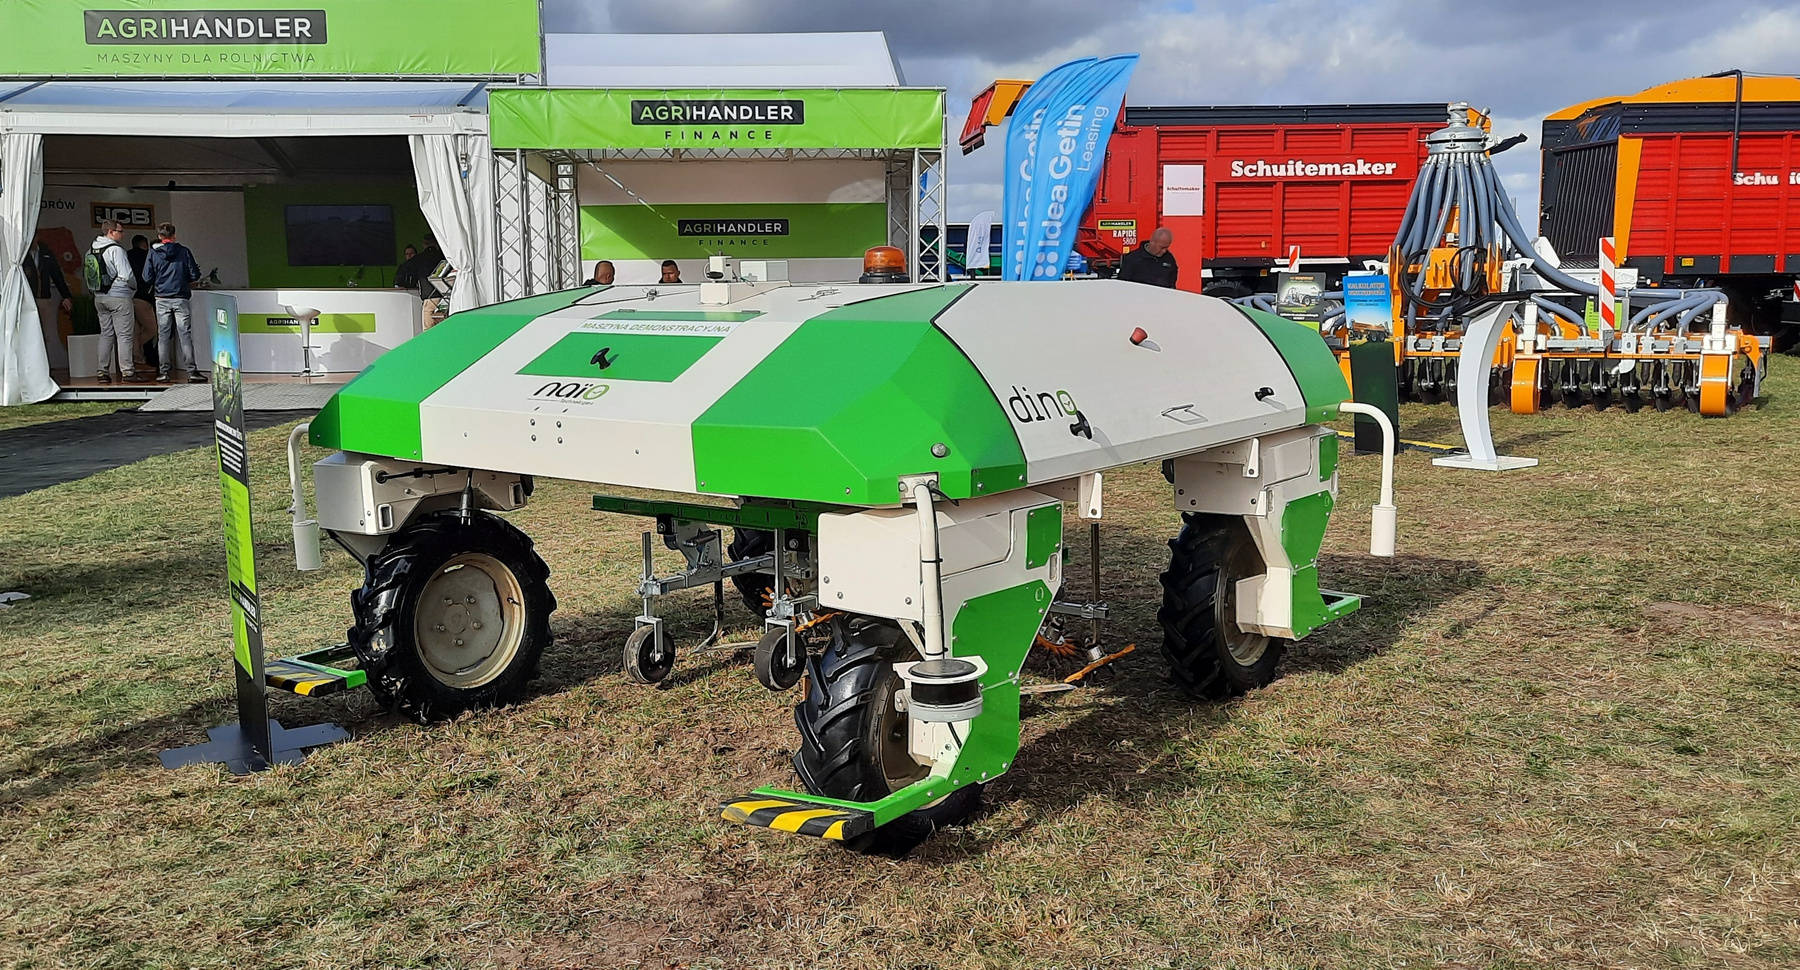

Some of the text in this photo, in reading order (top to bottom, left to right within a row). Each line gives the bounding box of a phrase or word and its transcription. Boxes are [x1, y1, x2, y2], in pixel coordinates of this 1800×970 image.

[97, 18, 312, 39] AGRIHANDLER
[97, 52, 316, 63] MASZYNY DLA ROLNICTWA
[640, 105, 794, 120] AGRIHANDLER
[665, 130, 772, 140] FINANCE
[1076, 106, 1110, 172] Leasing
[1038, 104, 1086, 247] Idea Getin
[1231, 159, 1397, 178] Schuitemaker
[95, 208, 151, 225] JCB
[683, 223, 782, 233] AGRIHANDLER
[1112, 230, 1137, 238] RAPIDE
[581, 322, 731, 333] MASZYNA DEMONSTRACYJNA
[1009, 385, 1078, 423] dino
